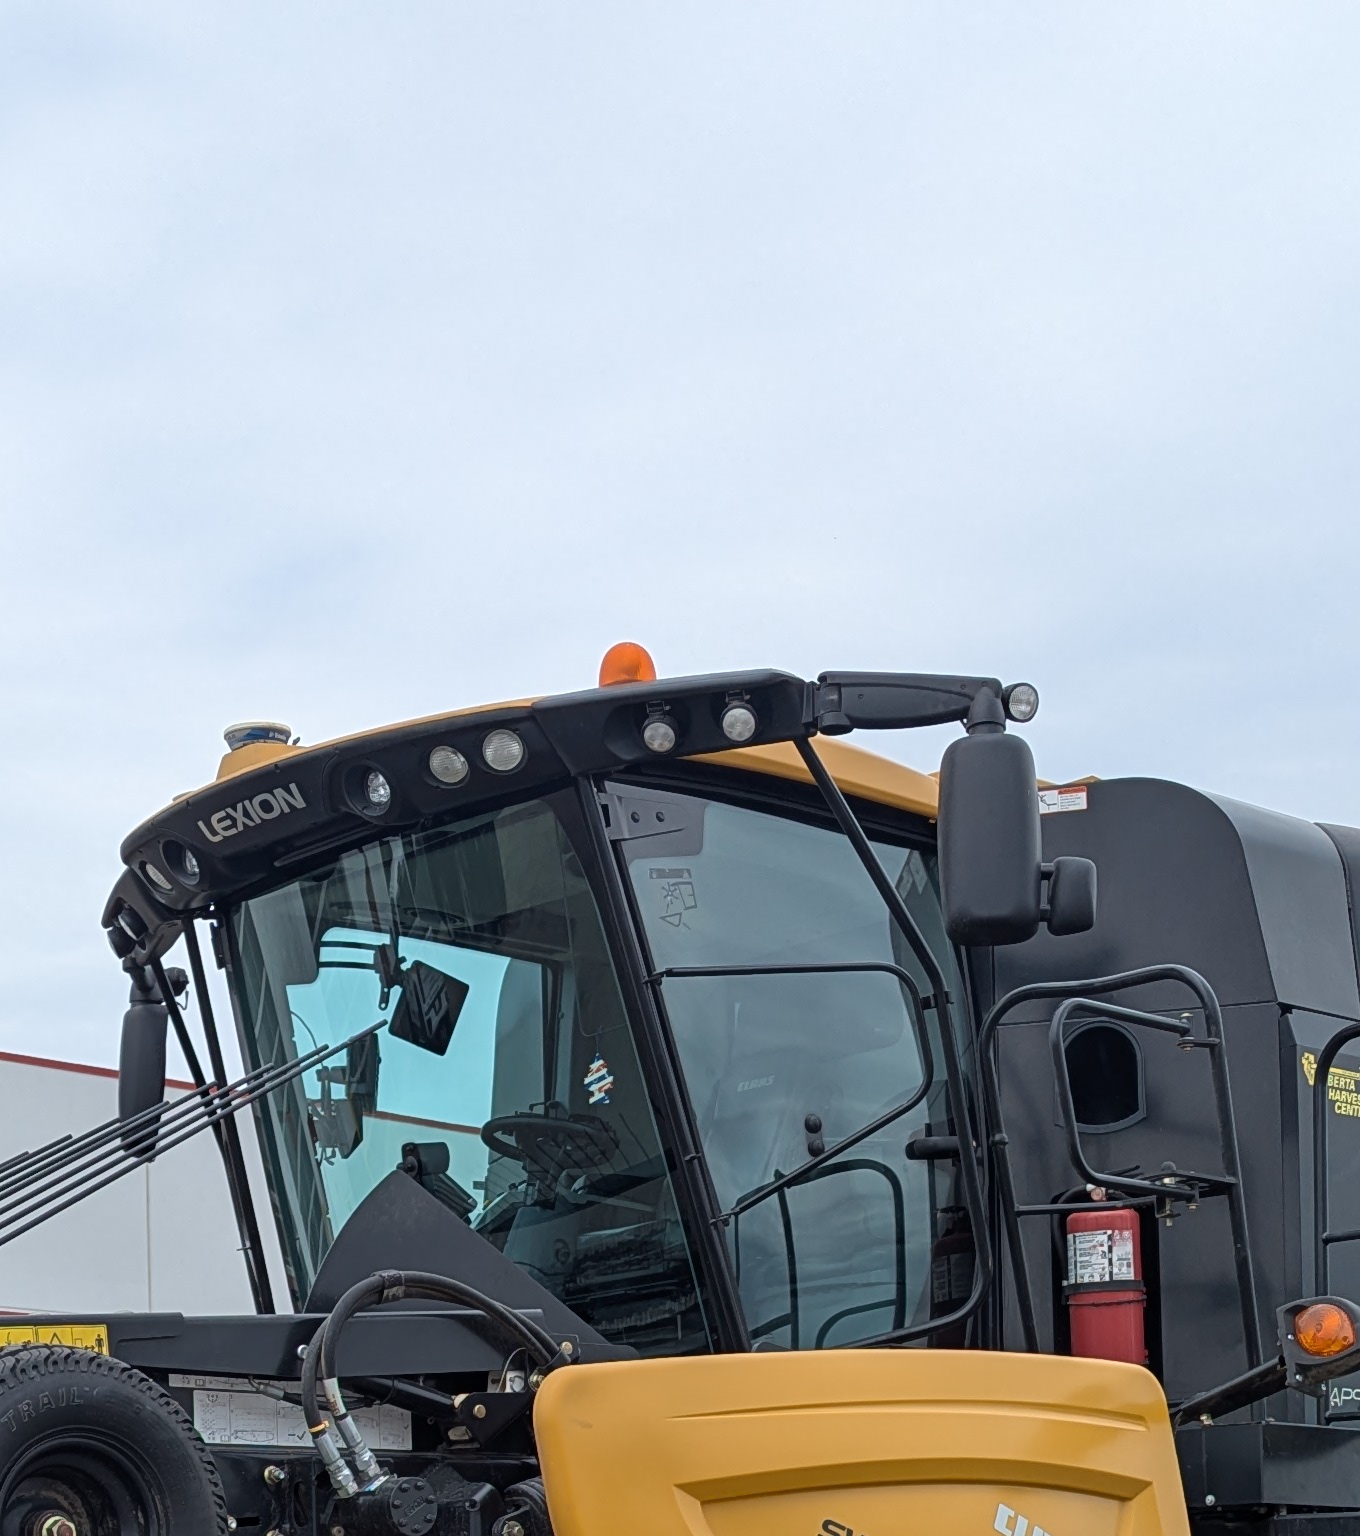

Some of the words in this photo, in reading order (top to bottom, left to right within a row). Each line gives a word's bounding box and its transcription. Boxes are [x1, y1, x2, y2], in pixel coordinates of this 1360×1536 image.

[197, 782, 307, 843] LEXION
[1327, 1075, 1356, 1091] BERTA
[0, 1386, 83, 1432] TRAIL
